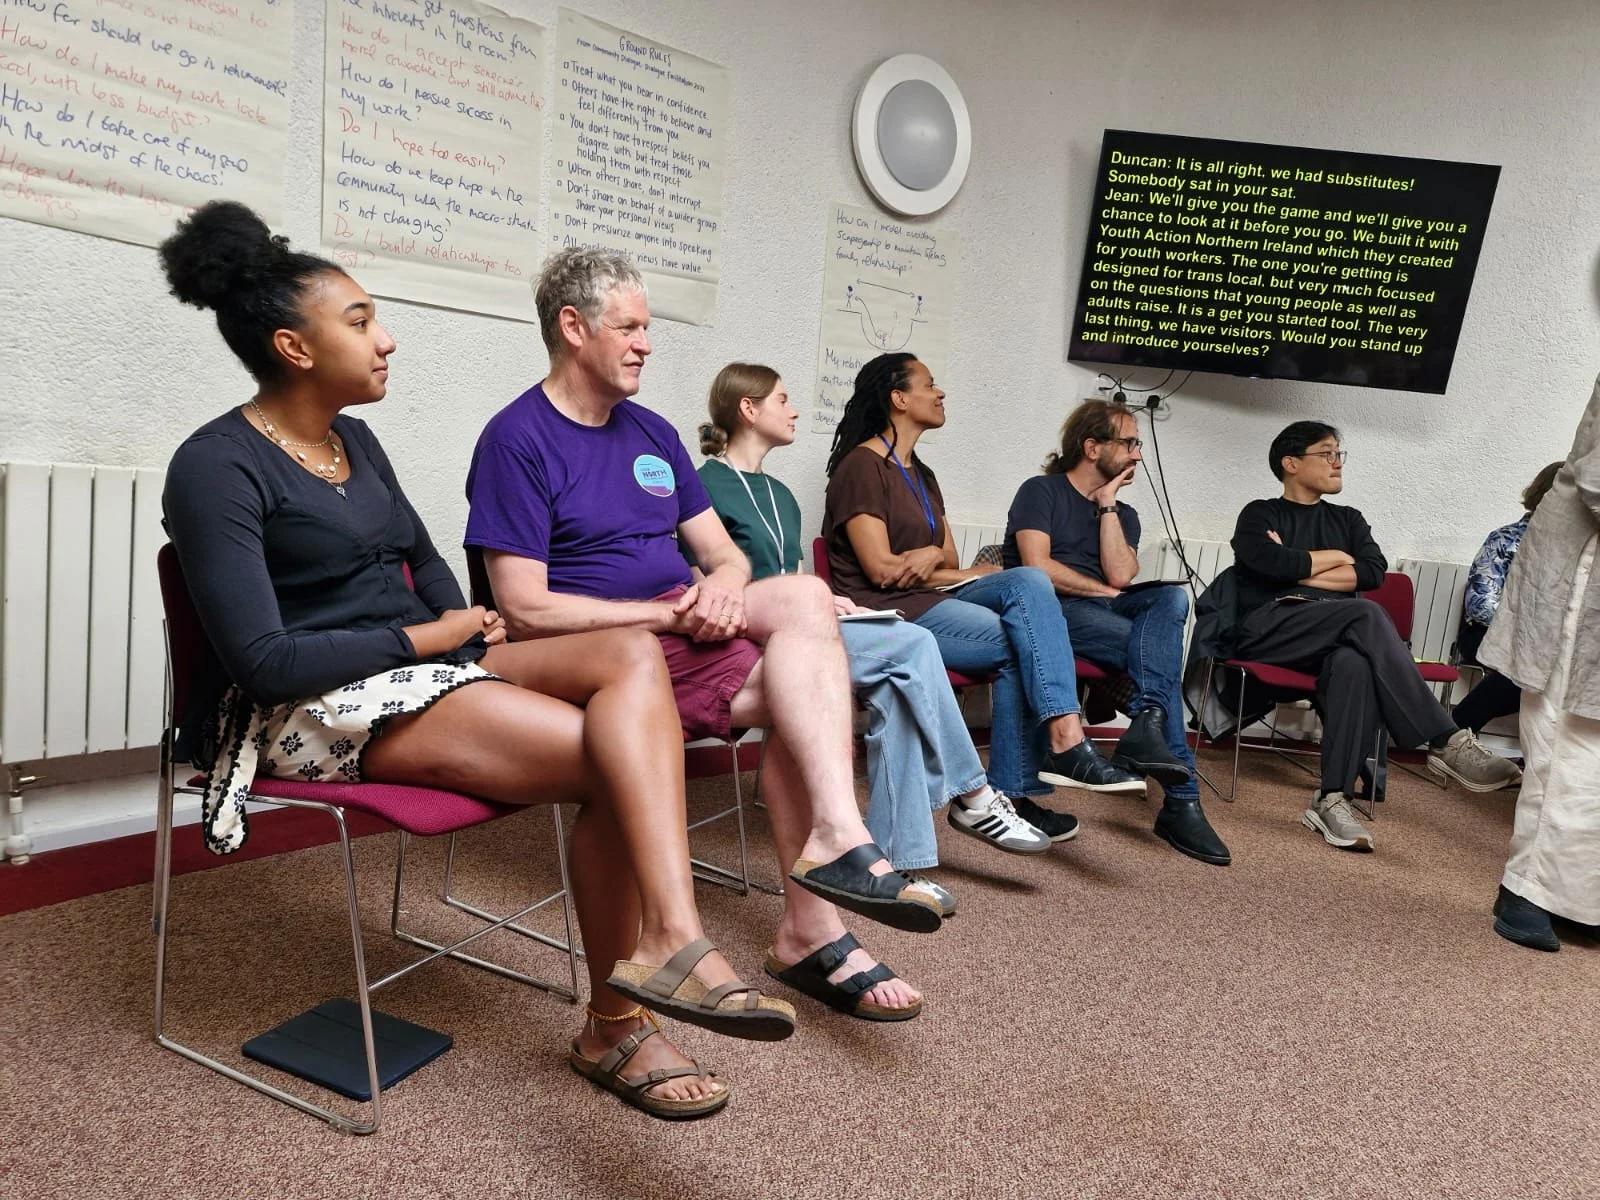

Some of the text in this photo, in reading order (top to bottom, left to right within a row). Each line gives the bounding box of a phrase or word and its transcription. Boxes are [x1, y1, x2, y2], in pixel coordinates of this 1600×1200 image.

[620, 36, 671, 67] GROUND RULES
[571, 60, 594, 79] Treat
[597, 72, 616, 87] what
[618, 79, 633, 93] you
[637, 84, 653, 98] hear
[655, 93, 664, 102] in
[2, 82, 43, 113] How
[56, 103, 75, 122] do
[101, 115, 139, 141] take
[176, 136, 192, 156] of
[572, 80, 712, 139] Others have the right to believe and
[578, 96, 664, 132] feel differently from
[61, 137, 120, 160] midst
[129, 152, 147, 168] of
[338, 106, 506, 176] Do I hope too easily?
[341, 141, 376, 167] How
[385, 160, 402, 174] do
[408, 169, 424, 180] we
[458, 175, 483, 197] hope
[577, 146, 682, 188] holding them with respect
[1108, 169, 1296, 199] Somebody sat in your sat.
[1111, 151, 1172, 168] Duncan:
[1176, 156, 1186, 170] It
[1189, 158, 1202, 172] is
[1206, 160, 1225, 173] all
[1271, 169, 1291, 180] we
[1295, 168, 1323, 183] had
[1326, 172, 1415, 191] substitutes!
[339, 199, 452, 243] is not changing?
[836, 208, 854, 225] How
[1102, 206, 1459, 251] chance to look at it before you go. We built it with
[1104, 188, 1467, 234] Jean: We'll give you the game and we'll give you a
[565, 214, 712, 263] Don't pressurize anyone into speaking
[1100, 224, 1454, 268] Youth Action Northern Ireland which they created
[1093, 260, 1160, 278] designed
[1163, 265, 1184, 279] for
[1187, 268, 1223, 283] trans
[1270, 275, 1294, 290] but
[1298, 281, 1329, 295] very
[1332, 284, 1372, 297] much
[1376, 285, 1435, 303] focused
[1096, 241, 1409, 284] for youth workers. The one you're getting is
[1087, 295, 1428, 340] adults raise. It is a get you started tool. The very
[1090, 279, 1417, 319] on the questions that young people as well as
[1081, 330, 1270, 357] and introduce yourselves?
[1084, 311, 1111, 326] last
[1158, 321, 1178, 331] we
[1182, 321, 1216, 335] have
[1220, 325, 1275, 340] visitors.
[1281, 329, 1327, 345] Would
[1329, 337, 1356, 349] you
[1360, 338, 1401, 352] stand
[1404, 344, 1423, 357] up
